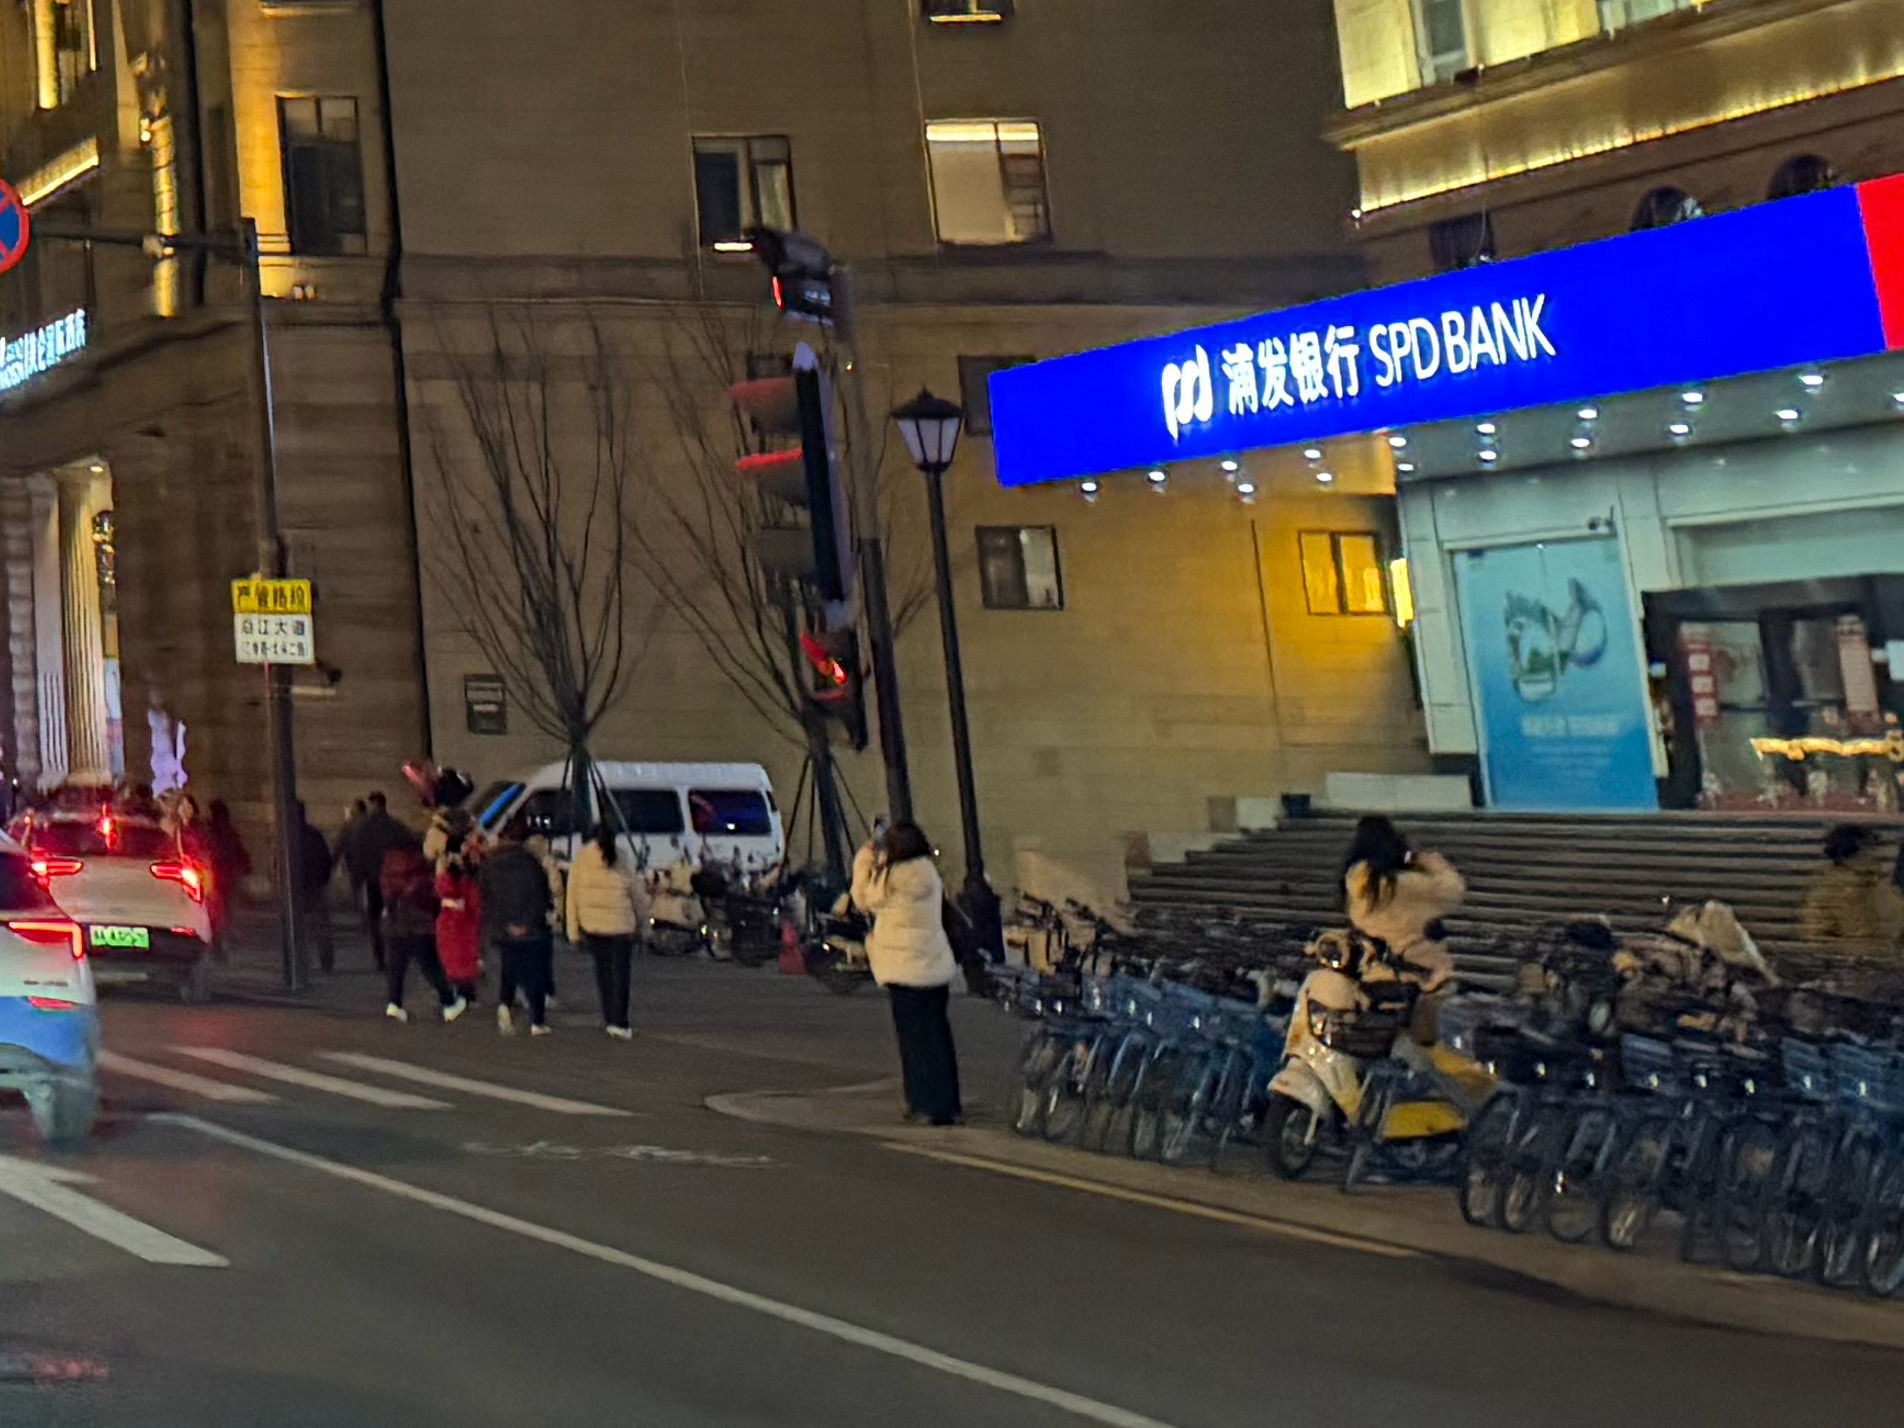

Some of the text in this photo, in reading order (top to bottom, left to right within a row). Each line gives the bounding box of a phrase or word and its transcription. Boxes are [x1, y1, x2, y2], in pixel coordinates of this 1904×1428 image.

[1221, 293, 1556, 416] 浦发银行 SPD BANK
[241, 618, 306, 636] 沿江大道
